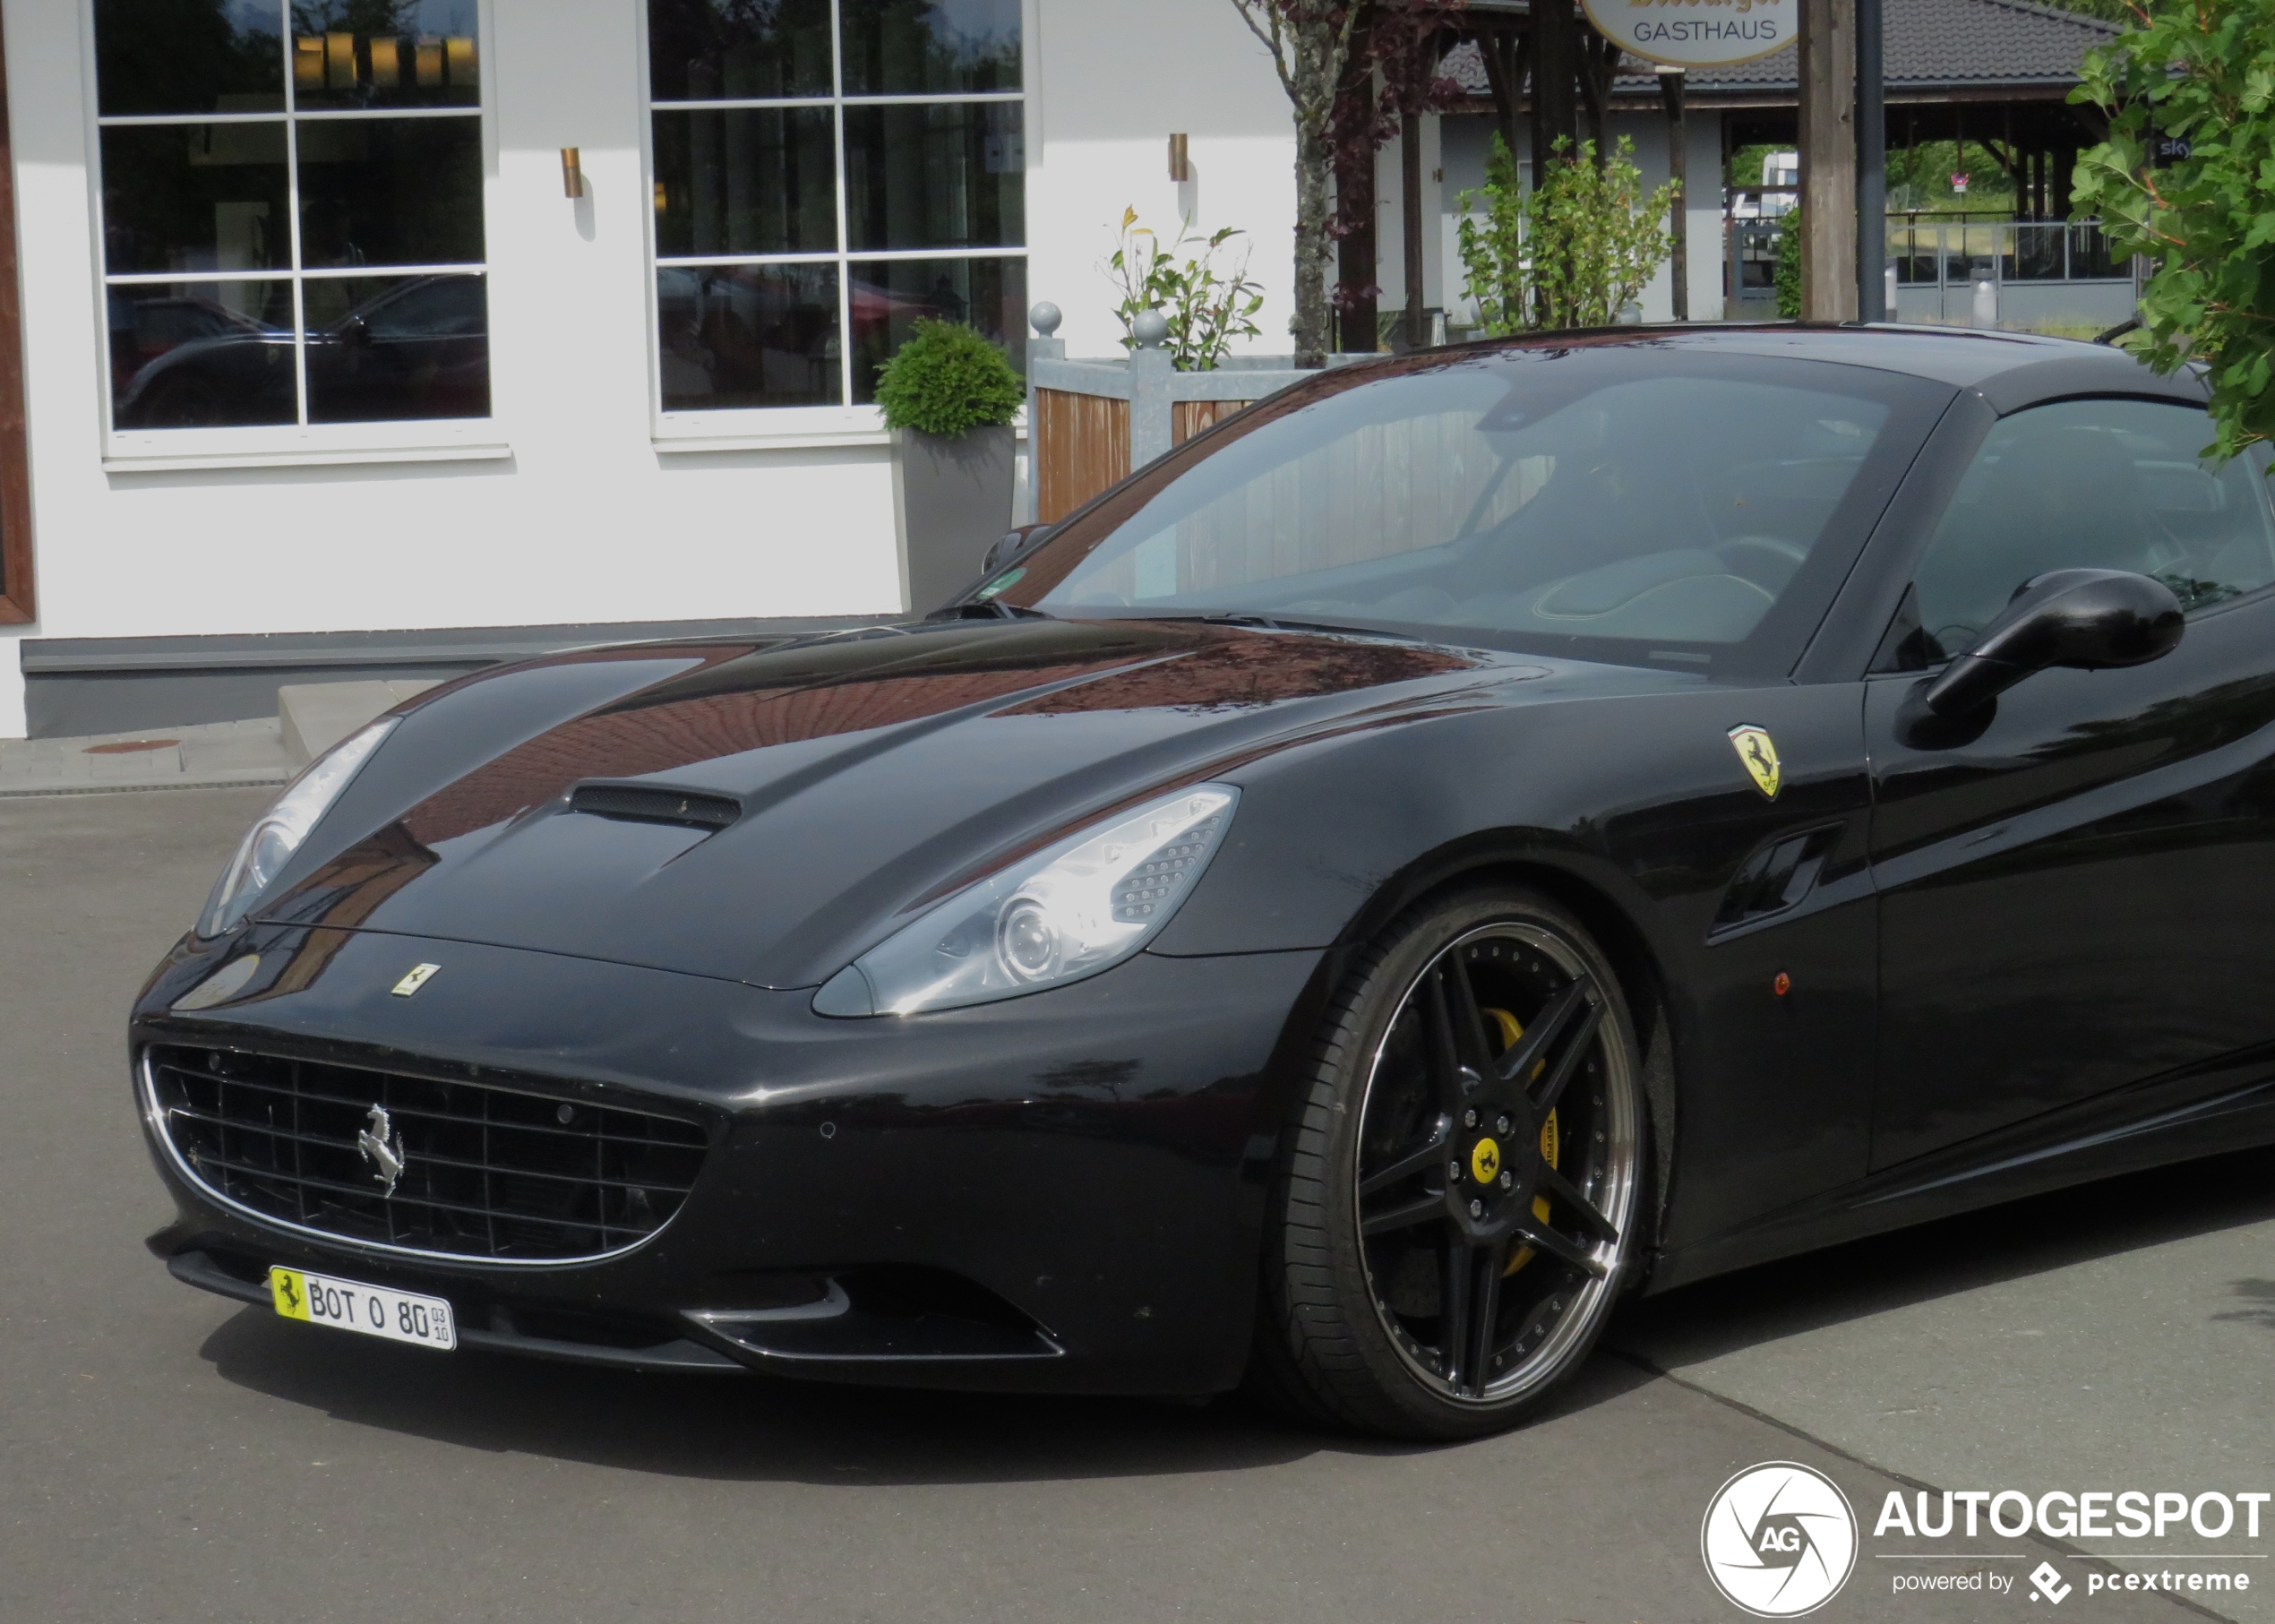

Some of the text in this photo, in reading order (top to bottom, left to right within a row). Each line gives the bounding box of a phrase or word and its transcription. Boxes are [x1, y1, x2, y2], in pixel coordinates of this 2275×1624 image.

[1634, 20, 1777, 41] GASTHAUS
[309, 1283, 355, 1323] BOT
[398, 1302, 429, 1337] 80
[432, 1307, 445, 1323] 03
[435, 1327, 448, 1341] 10
